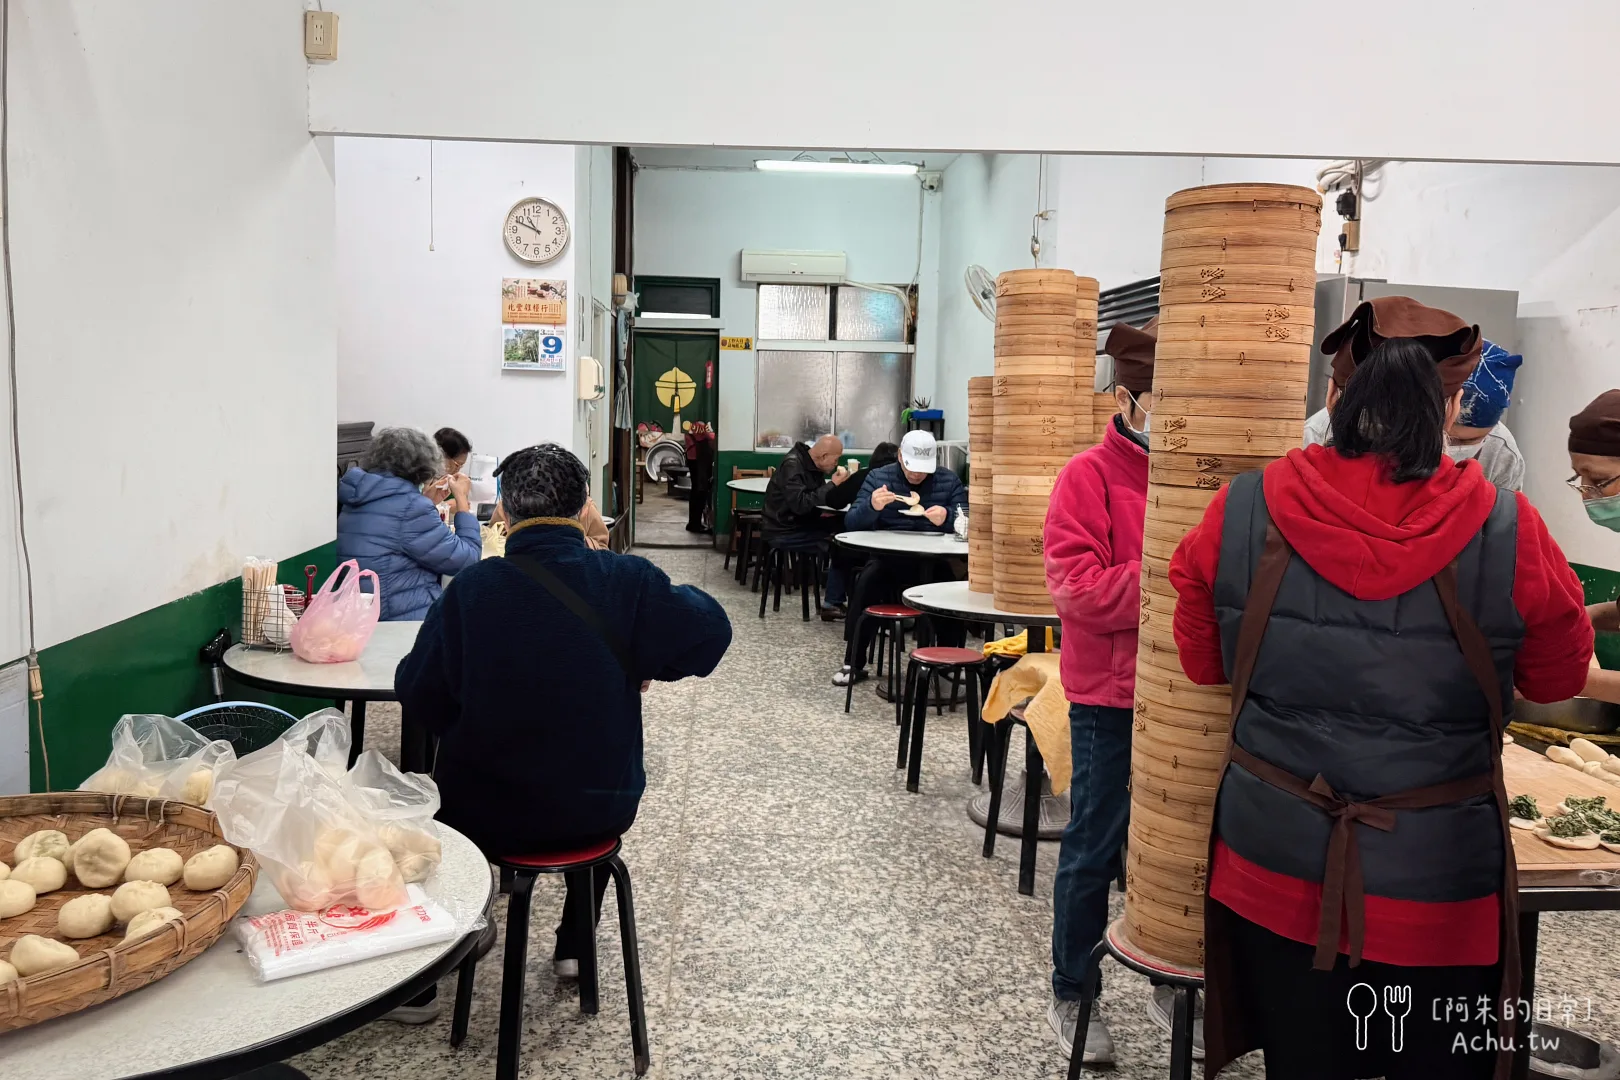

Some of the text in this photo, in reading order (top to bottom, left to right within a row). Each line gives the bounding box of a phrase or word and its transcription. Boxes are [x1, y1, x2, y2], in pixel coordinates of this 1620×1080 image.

[523, 208, 530, 216] 11
[532, 205, 542, 214] 12
[546, 209, 550, 217] 1
[515, 215, 524, 224] 10
[552, 216, 558, 225] 2
[511, 225, 518, 234] 9
[555, 226, 562, 235] 3
[515, 236, 522, 245] 8
[552, 237, 557, 245] 4
[523, 243, 529, 252] 7
[533, 247, 540, 255] 6
[544, 244, 551, 253] 5
[542, 335, 563, 354] 9
[305, 921, 319, 934] 半斤
